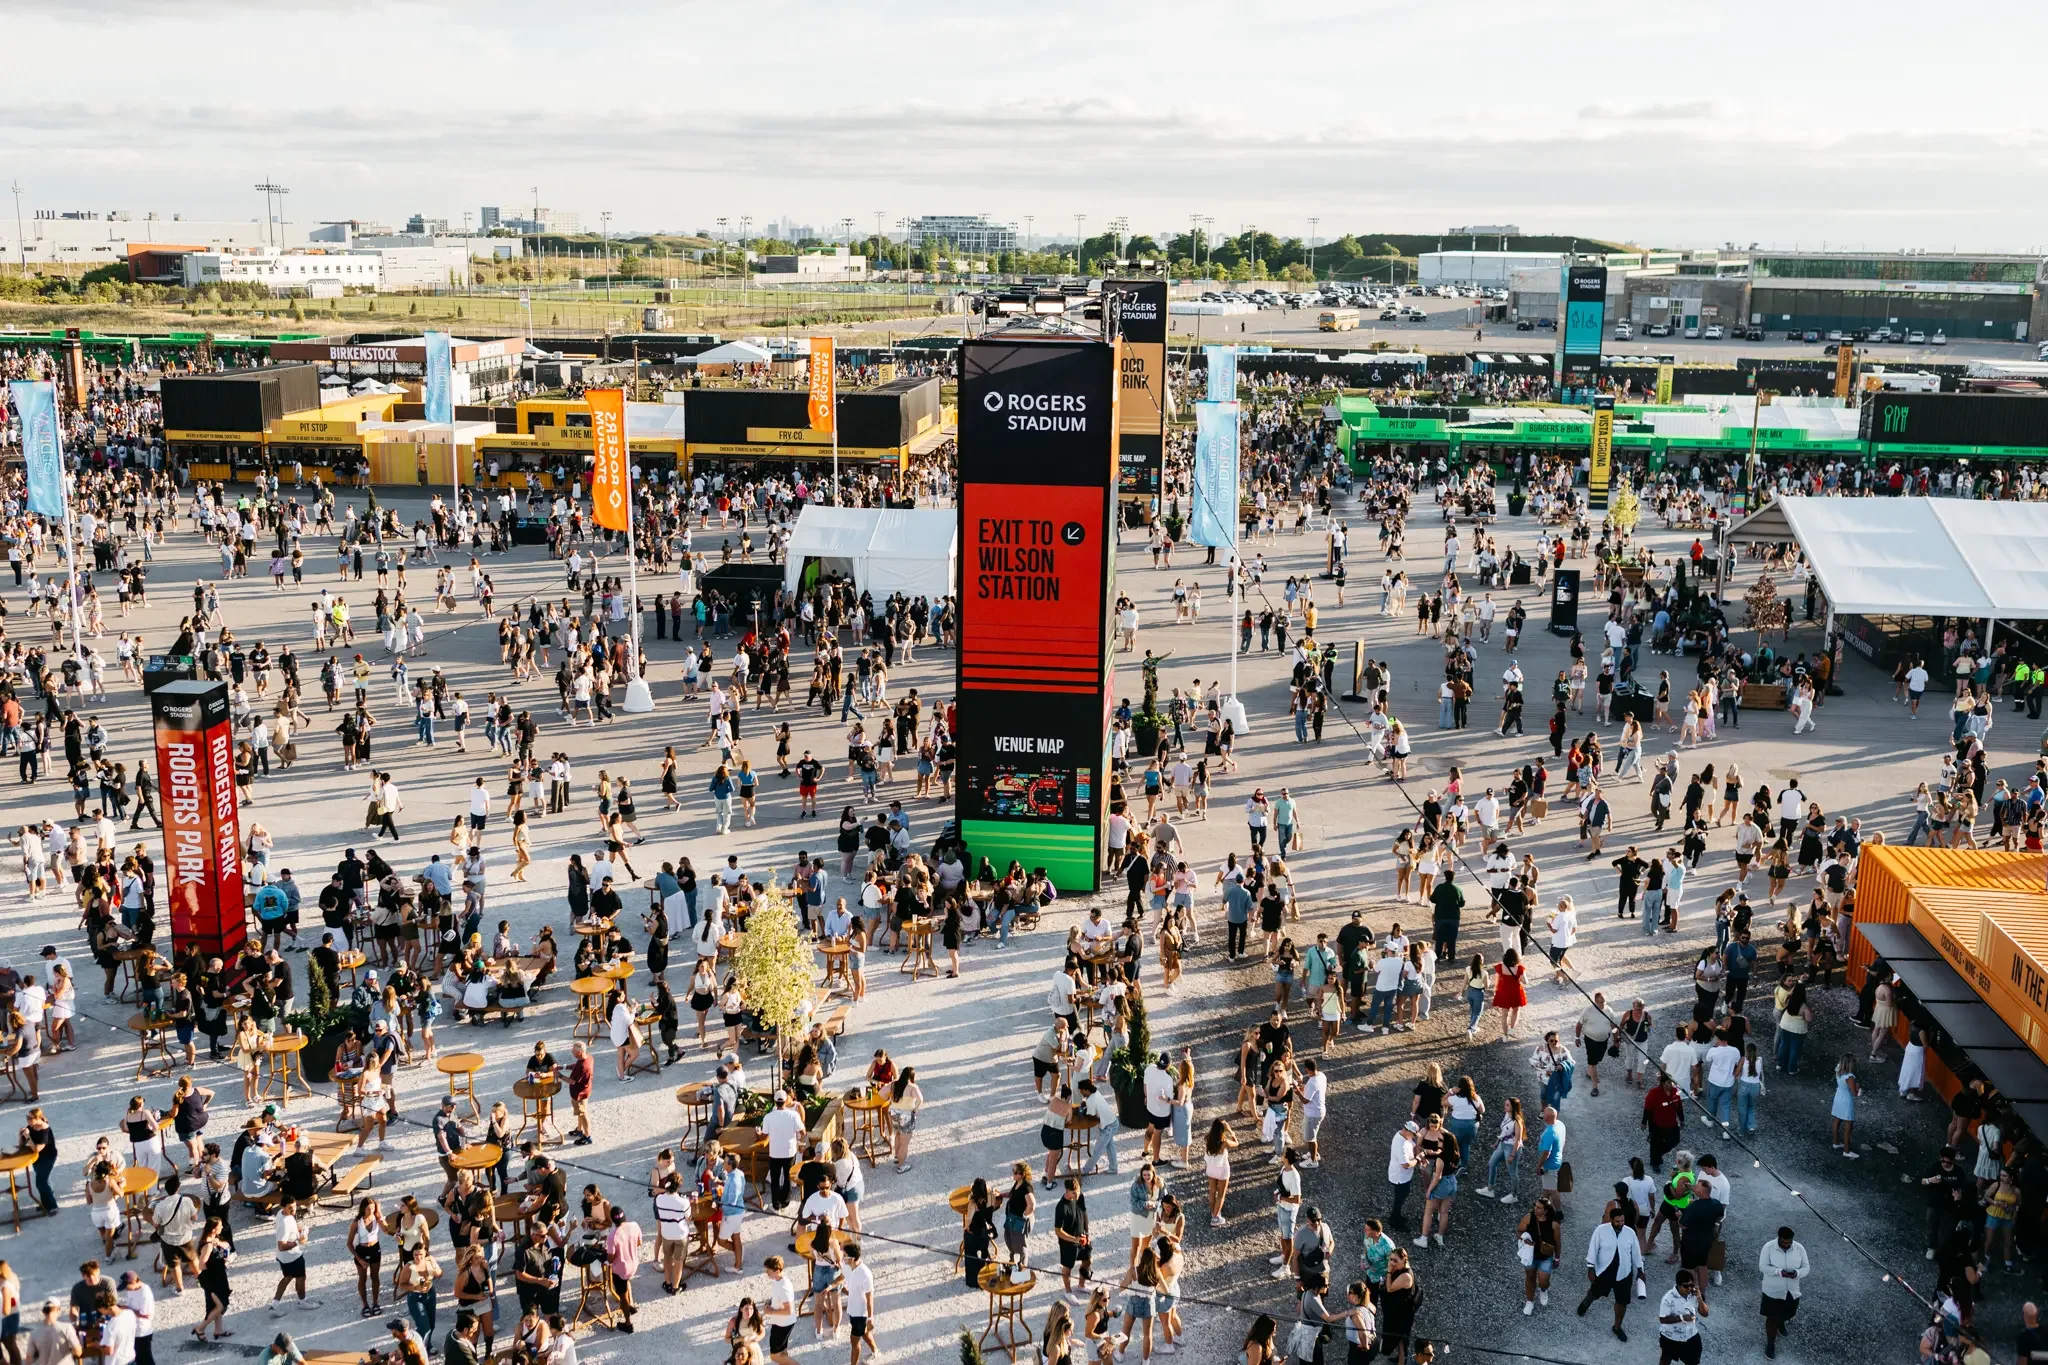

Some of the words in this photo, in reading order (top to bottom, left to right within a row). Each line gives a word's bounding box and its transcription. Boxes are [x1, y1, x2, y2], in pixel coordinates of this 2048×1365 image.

[1122, 302, 1156, 311] ROGERS
[330, 346, 397, 361] BIRKENSTOCK
[1122, 358, 1144, 372] OOD
[1122, 374, 1150, 390] RINK
[1008, 394, 1086, 412] ROGERS
[300, 422, 309, 432] PIT
[312, 423, 328, 432] STOP
[1008, 415, 1086, 432] STADIUM
[1389, 420, 1399, 429] PIT
[1400, 420, 1417, 429] STOP
[1529, 424, 1559, 433] BURGERS
[1560, 424, 1565, 432] &
[1566, 425, 1584, 434] BUNS
[1598, 414, 1609, 436] VISTA
[560, 429, 568, 438] IN
[570, 430, 582, 438] THE
[584, 430, 594, 438] MI
[779, 430, 791, 440] FRY
[793, 431, 804, 441] CO.
[1770, 430, 1783, 439] MIX
[1596, 438, 1608, 468] CORONA
[979, 518, 1023, 544] EXIT
[1028, 520, 1053, 545] TO
[978, 546, 1054, 574] WILSON
[978, 574, 1060, 601] STATION
[1559, 683, 1568, 692] 12
[212, 698, 224, 708] ROGERS
[212, 704, 225, 713] STADIUM
[994, 736, 1034, 752] VENUE
[1037, 738, 1064, 754] MAP
[168, 743, 200, 825] ROGERS
[212, 734, 232, 820] ROGERS
[176, 830, 205, 886] PARK
[219, 820, 237, 881] PARK
[1940, 934, 1962, 965] COCKTAILS
[1964, 960, 1976, 979] WINE
[1978, 973, 1991, 994] BEER
[2011, 953, 2022, 987] IN
[2024, 964, 2045, 1008] THE
